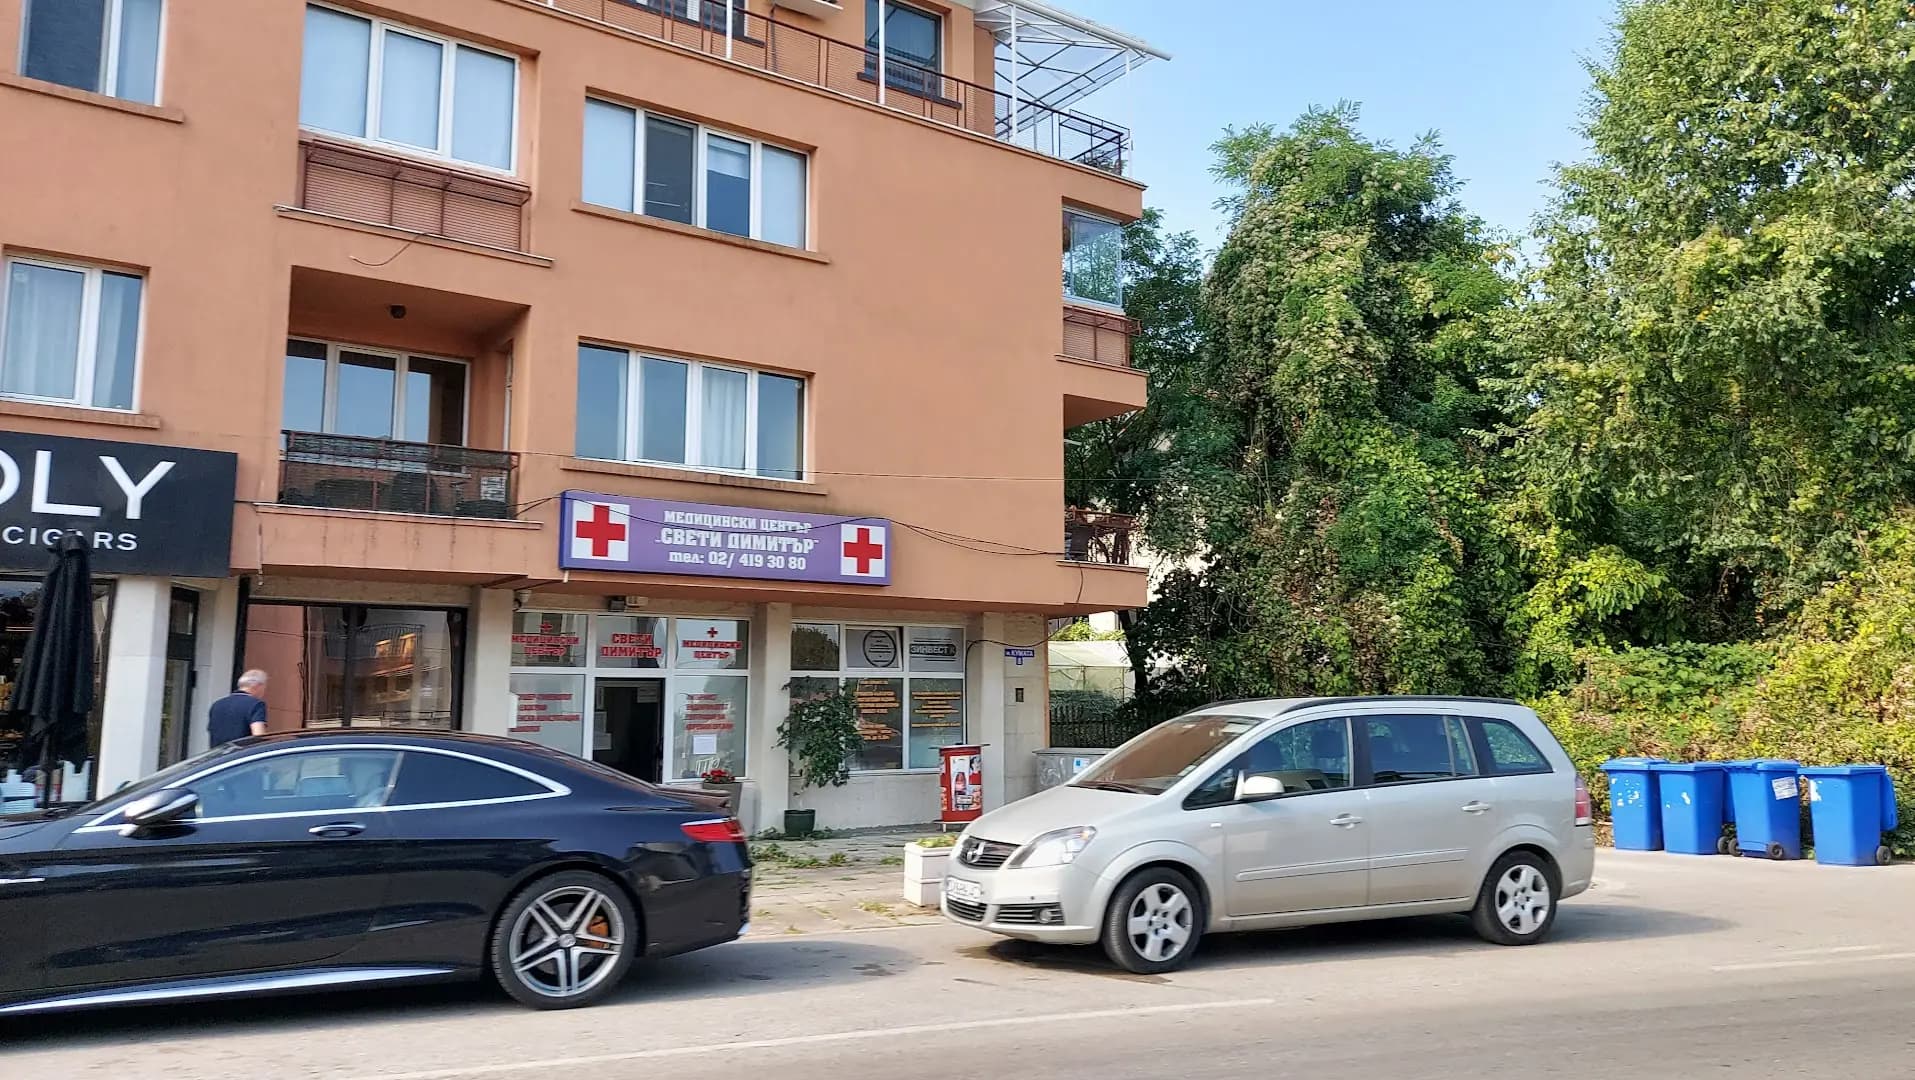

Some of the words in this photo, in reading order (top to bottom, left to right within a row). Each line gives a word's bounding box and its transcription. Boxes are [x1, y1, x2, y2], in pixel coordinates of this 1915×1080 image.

[664, 510, 756, 529] МЕДИЦИНСКИ
[2, 526, 138, 550] CIGRS
[668, 551, 705, 564] тел:
[739, 553, 763, 568] 419
[767, 555, 785, 569] 30
[788, 557, 806, 570] 80
